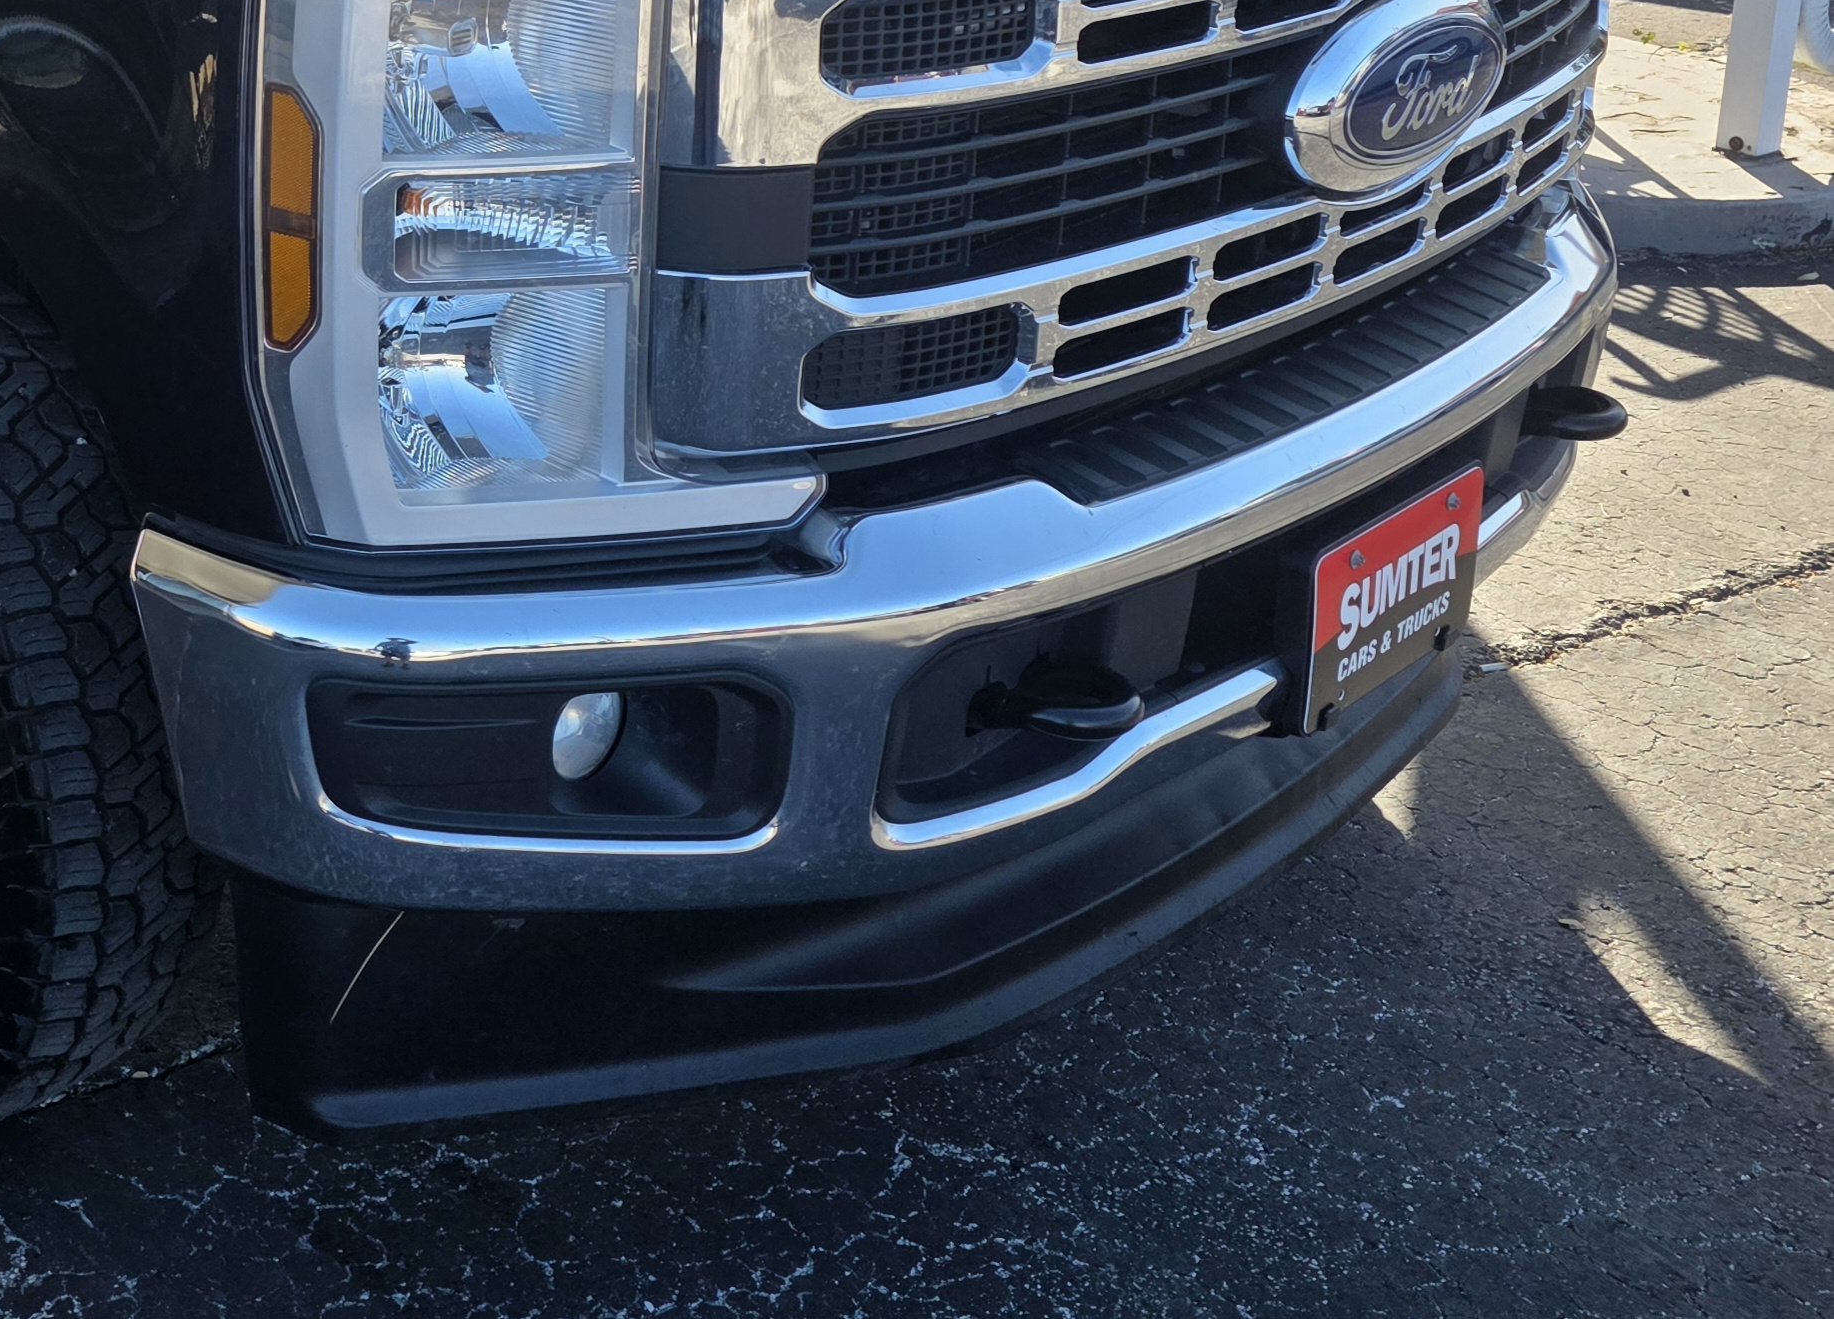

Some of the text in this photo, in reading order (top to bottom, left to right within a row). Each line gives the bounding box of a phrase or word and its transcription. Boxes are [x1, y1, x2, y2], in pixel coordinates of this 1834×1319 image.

[1380, 44, 1480, 142] Ford
[1336, 523, 1461, 652] SUMTER
[1337, 590, 1451, 683] CARS & TRUCKS
